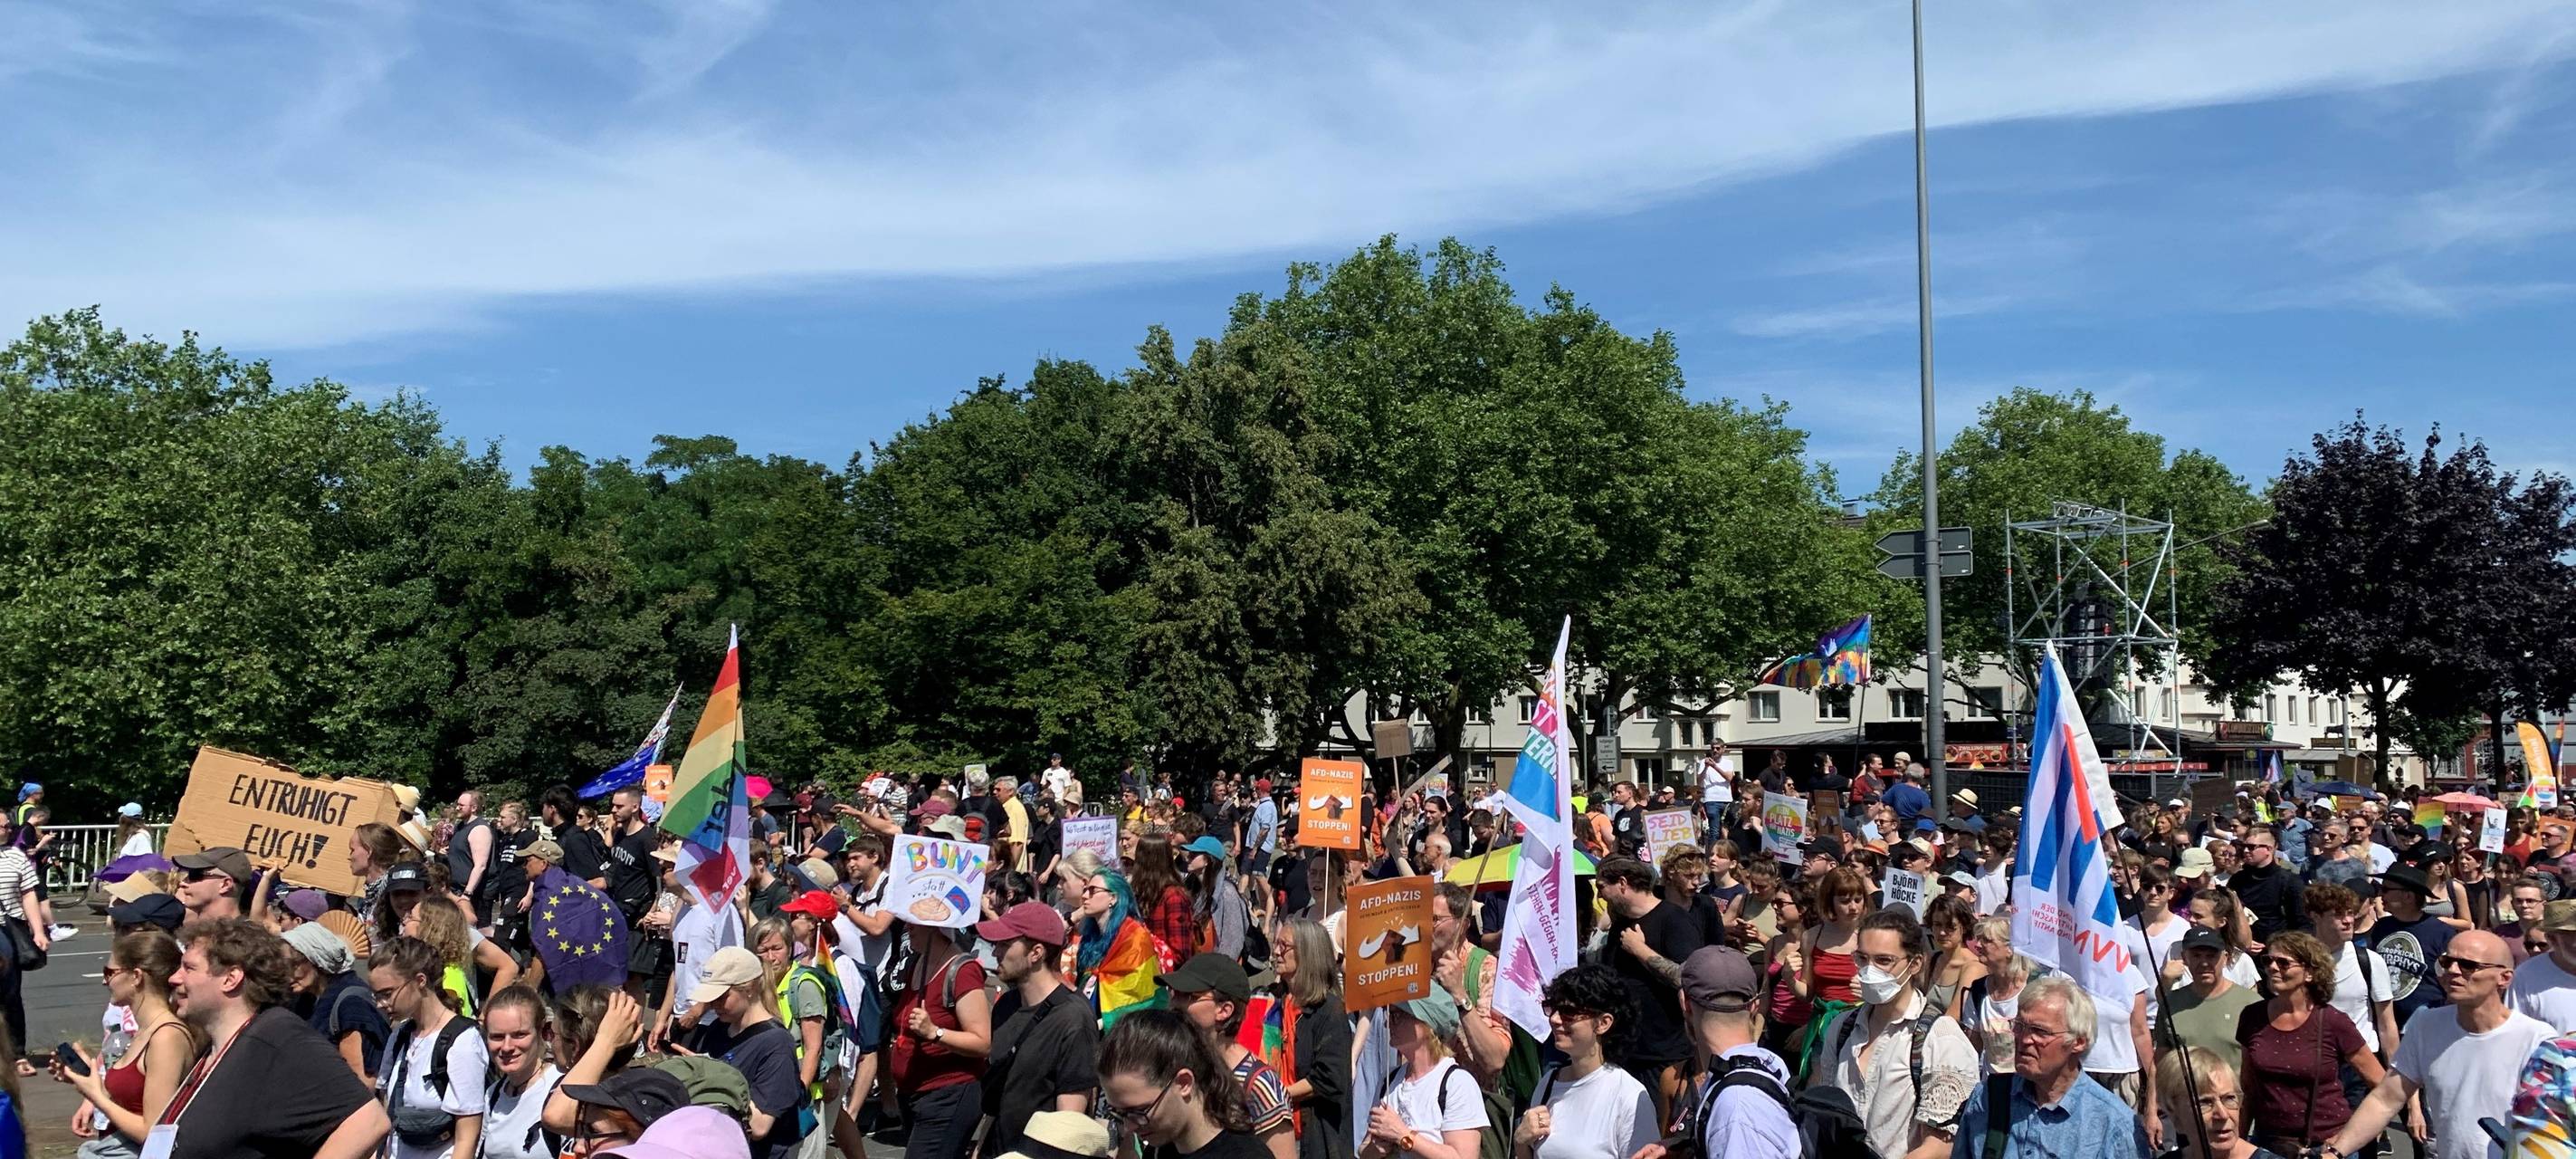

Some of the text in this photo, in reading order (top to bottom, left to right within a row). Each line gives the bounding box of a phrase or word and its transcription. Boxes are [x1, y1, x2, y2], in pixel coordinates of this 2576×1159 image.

[1311, 768, 1354, 779] AFD-NAZIS
[228, 773, 358, 826] ENTRUHIGT
[1306, 819, 1351, 831] STOPPEN!
[1648, 814, 1686, 829] SEID
[1770, 811, 1793, 828] PLATZ
[1651, 827, 1692, 843] LIEB
[243, 823, 329, 869] EUCH!
[906, 841, 986, 884] BUNT
[922, 878, 946, 891] statt
[1893, 874, 1918, 890] BJÖRN
[1360, 890, 1421, 910] AFD-NAZIS
[1891, 886, 1916, 904] HÖCKE
[1358, 963, 1418, 985] STOPPEN!
